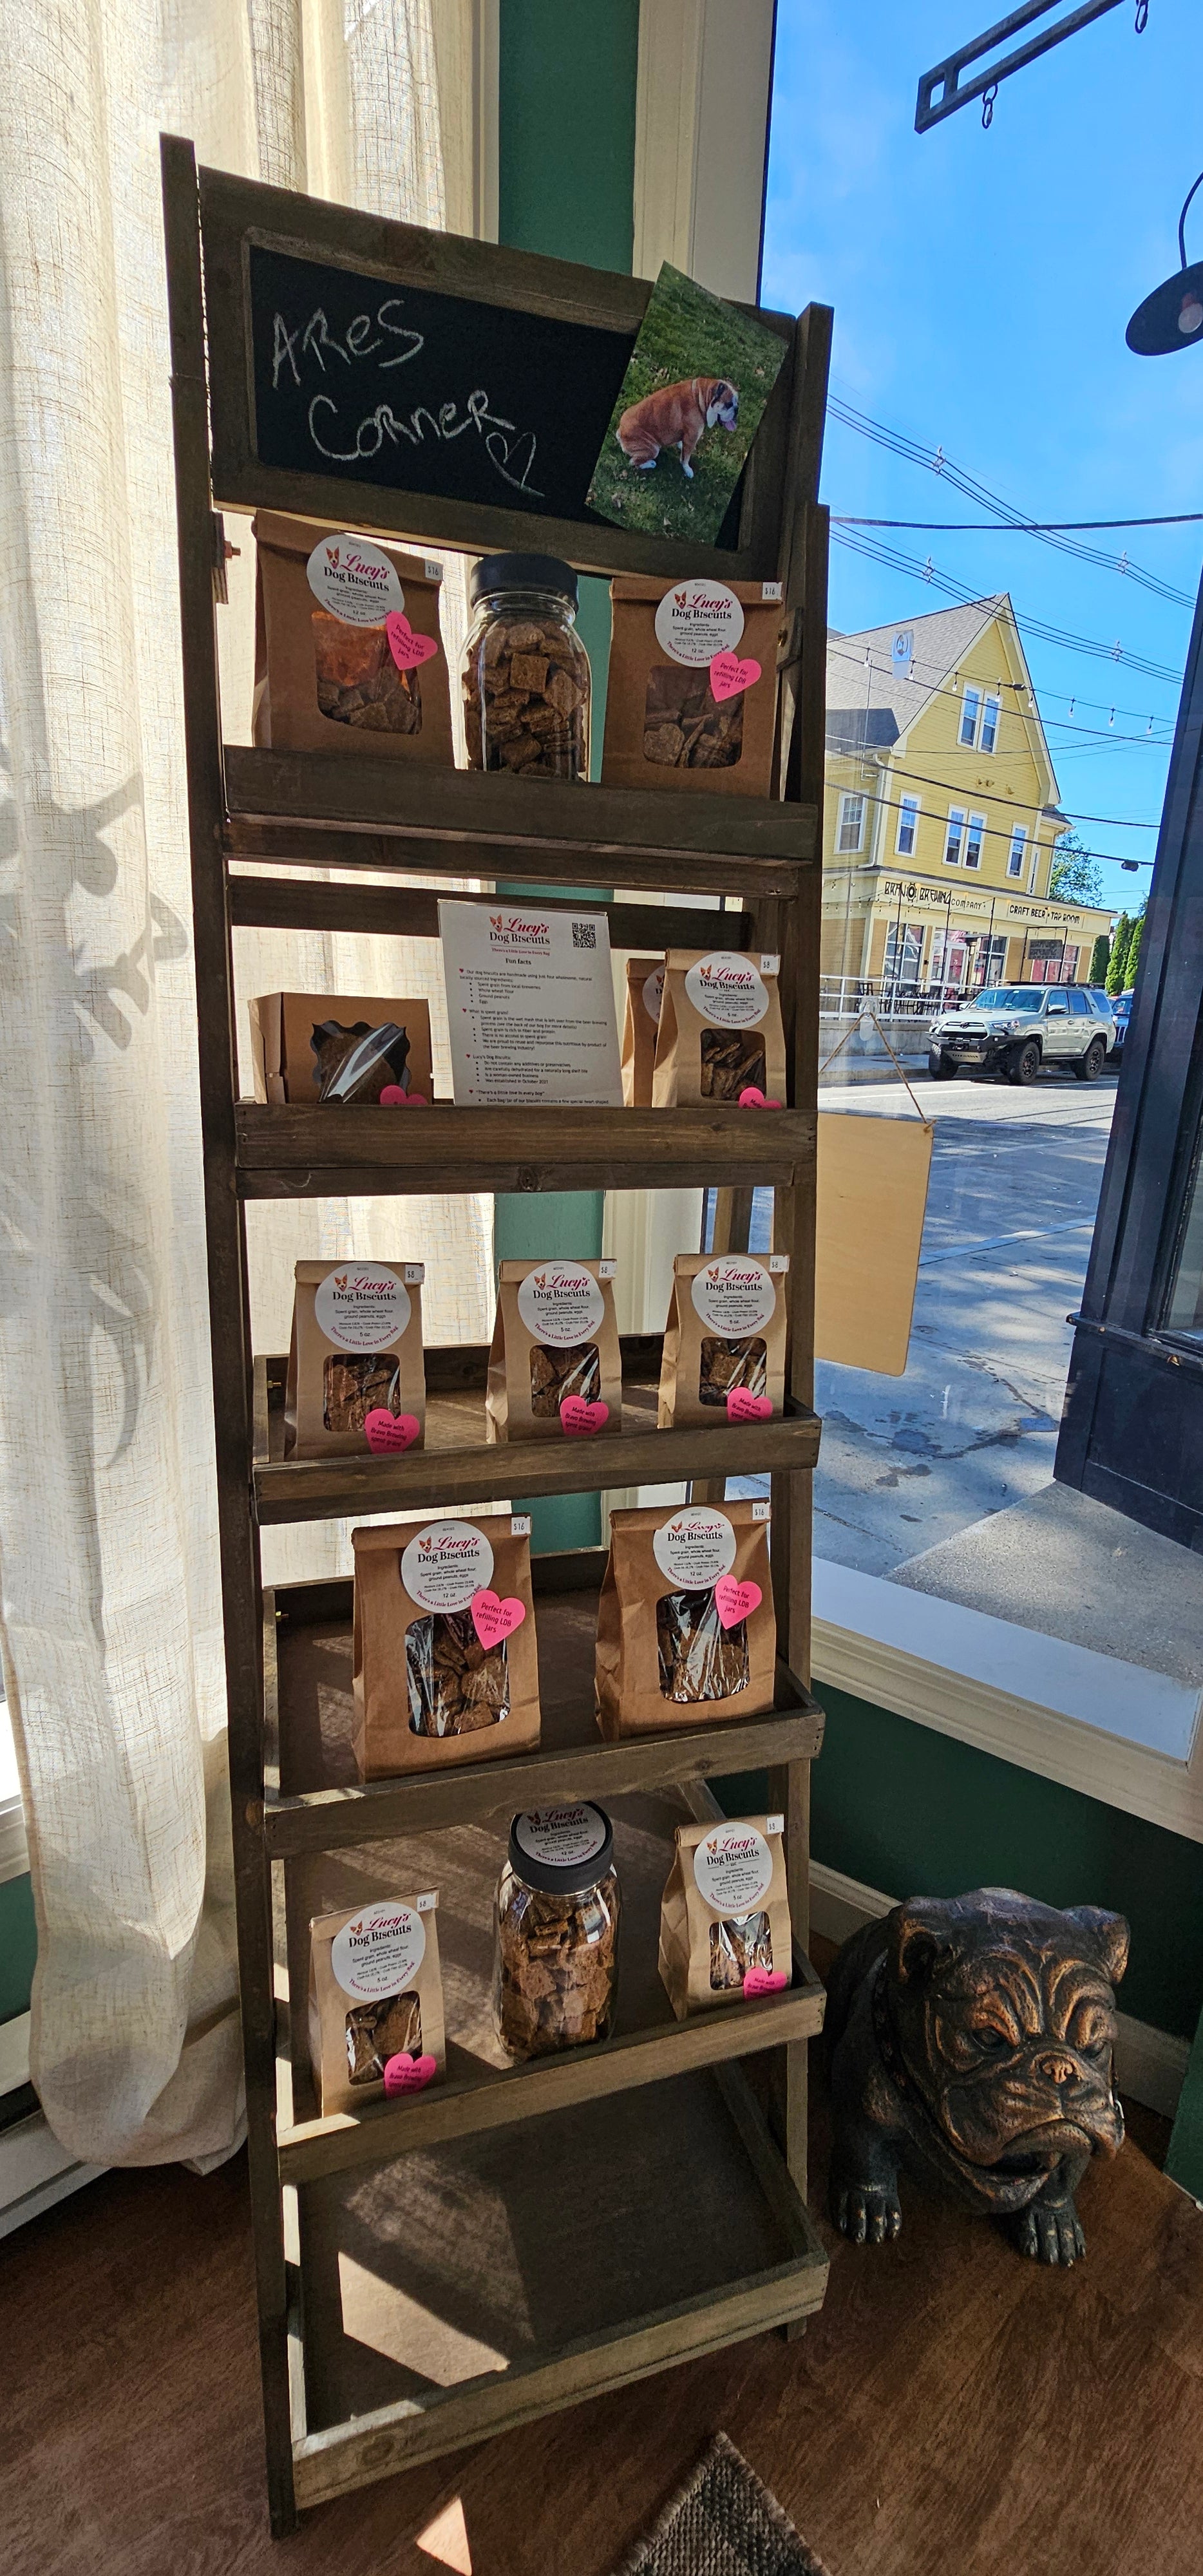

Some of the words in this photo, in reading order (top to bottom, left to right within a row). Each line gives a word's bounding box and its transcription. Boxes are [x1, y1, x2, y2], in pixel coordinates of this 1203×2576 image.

[340, 554, 390, 580] Lucy's
[428, 565, 439, 576] $16
[324, 566, 346, 583] Dog
[348, 573, 390, 591] Biscuits
[765, 587, 775, 596] $16
[687, 594, 733, 612] Lucy's
[672, 608, 692, 620] Dog
[693, 609, 732, 619] Biscuits
[391, 631, 411, 652] refilling
[395, 623, 413, 645] Perfect
[397, 648, 409, 659] jars
[720, 662, 739, 673] Perfect
[714, 670, 734, 681] refilling
[951, 898, 982, 910] COMPANY
[1010, 905, 1030, 916] CRAFT
[1030, 908, 1046, 919] BEER
[1051, 911, 1062, 921] TAP
[1063, 914, 1080, 924] ROOM
[504, 918, 549, 937] Lucy's
[489, 932, 509, 944] Dog
[511, 934, 550, 945] Biscuits
[712, 967, 754, 984] Lucy's
[699, 980, 718, 990] Dog
[719, 981, 755, 990] Biscuits
[546, 1274, 590, 1291] Lucy's
[719, 1268, 763, 1284] Lucy's
[348, 1276, 397, 1294] Lucy's
[706, 1282, 725, 1293] Dog
[726, 1282, 763, 1291] Biscuits
[333, 1291, 354, 1302] Dog
[355, 1292, 397, 1300] Biscuits
[533, 1290, 553, 1300] Dog
[553, 1289, 591, 1298] Biscuits
[739, 1398, 752, 1406] Made
[371, 1427, 386, 1435] Bravo
[433, 1536, 480, 1551] Lucy's
[668, 1533, 686, 1543] Dog
[688, 1531, 723, 1540] Biscuits
[418, 1553, 438, 1564] Dog
[440, 1549, 480, 1560] Biscuits
[723, 1586, 740, 1596] Perfect
[481, 1602, 502, 1615] Perfect
[503, 1609, 513, 1617] for
[738, 1600, 750, 1608] LDB
[477, 1612, 499, 1625] refilling
[500, 1617, 512, 1627] LDB
[484, 1624, 497, 1633] jars
[542, 1808, 585, 1823] Lucy's
[530, 1824, 550, 1833] Dog
[551, 1817, 589, 1829] Biscuits
[719, 1837, 757, 1852] Lucy's
[706, 1855, 725, 1866] Dog
[726, 1849, 760, 1862] Biscuits
[364, 1913, 412, 1932] Lucy's
[349, 1934, 370, 1947] Dog
[372, 1925, 412, 1942] Biscuits
